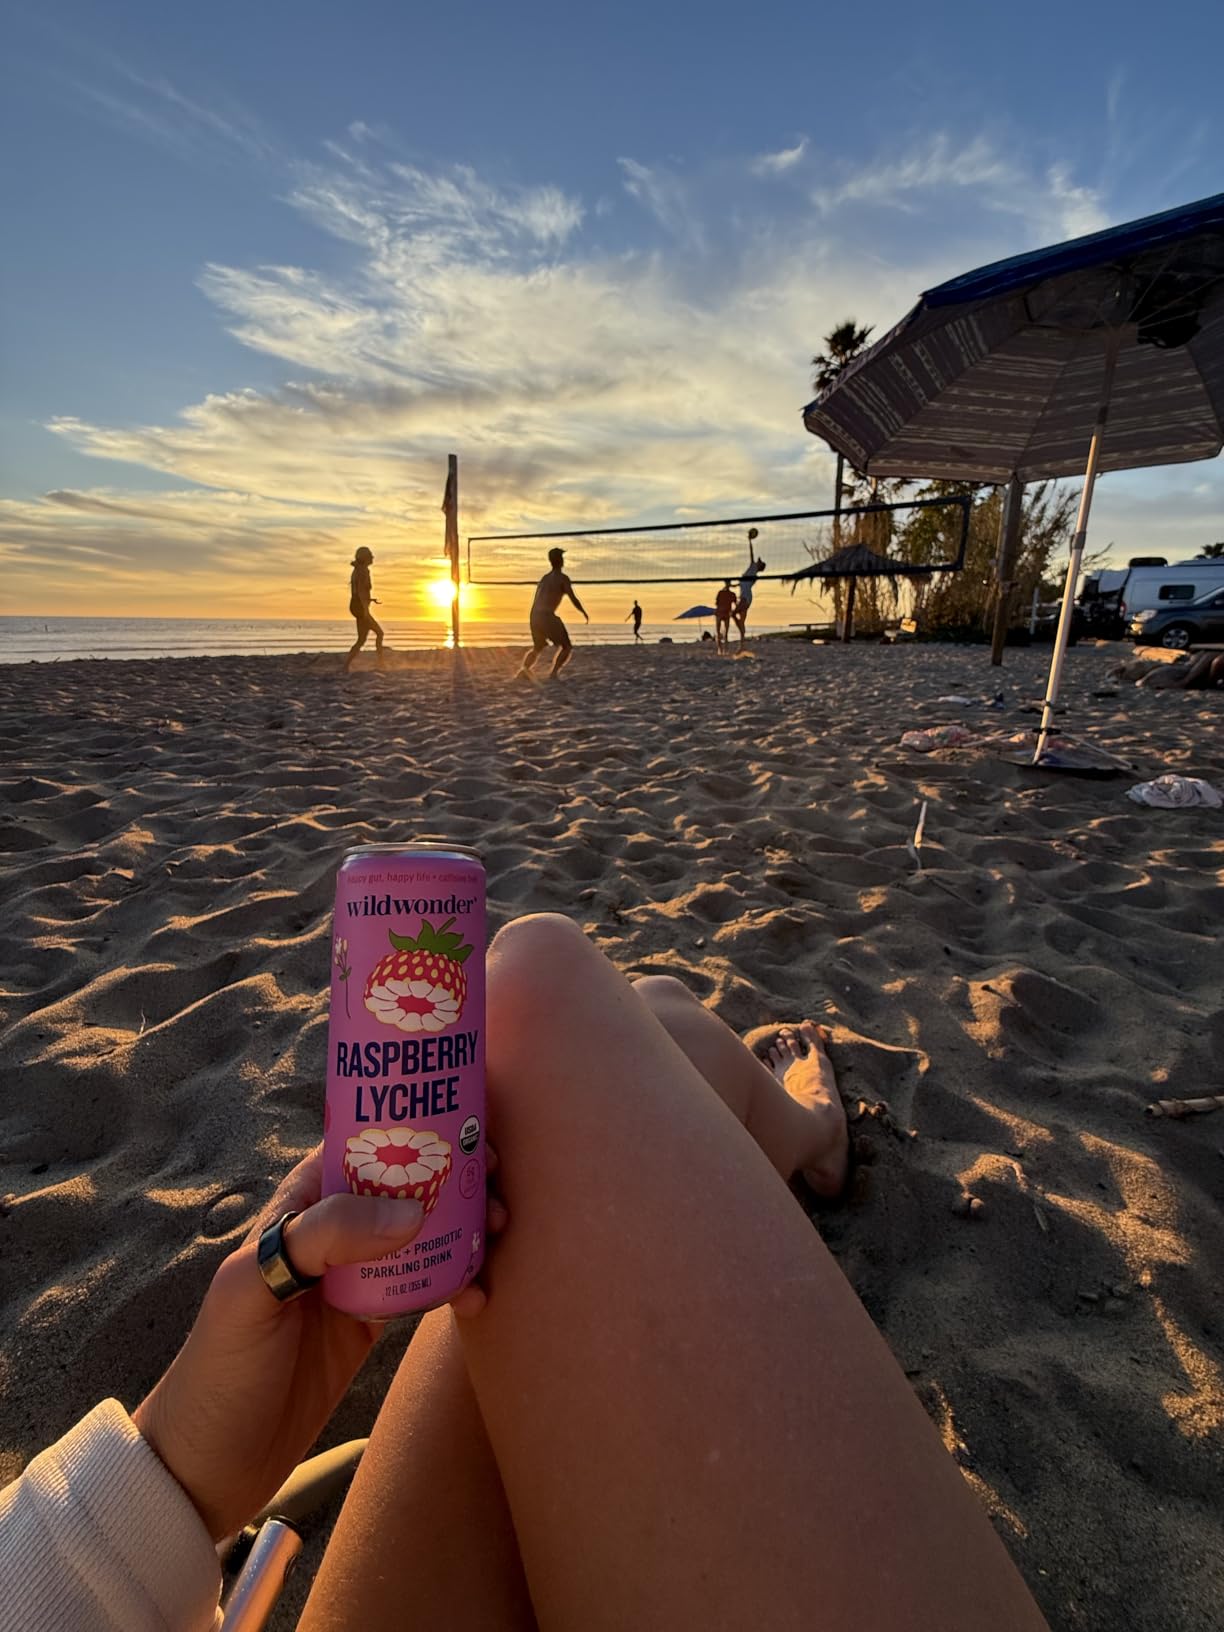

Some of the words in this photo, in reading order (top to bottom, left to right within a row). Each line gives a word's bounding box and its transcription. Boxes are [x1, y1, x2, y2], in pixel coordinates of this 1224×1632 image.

[387, 872, 414, 884] happy
[416, 872, 431, 881] life
[346, 894, 475, 918] wildwonder
[336, 1030, 478, 1078] RASPBERRY
[355, 1076, 460, 1122] LYCHEE
[414, 1228, 463, 1255] PROBIOTIC
[360, 1260, 420, 1279] SPARKLING
[423, 1249, 453, 1269] DRINK
[385, 1286, 392, 1297] 12
